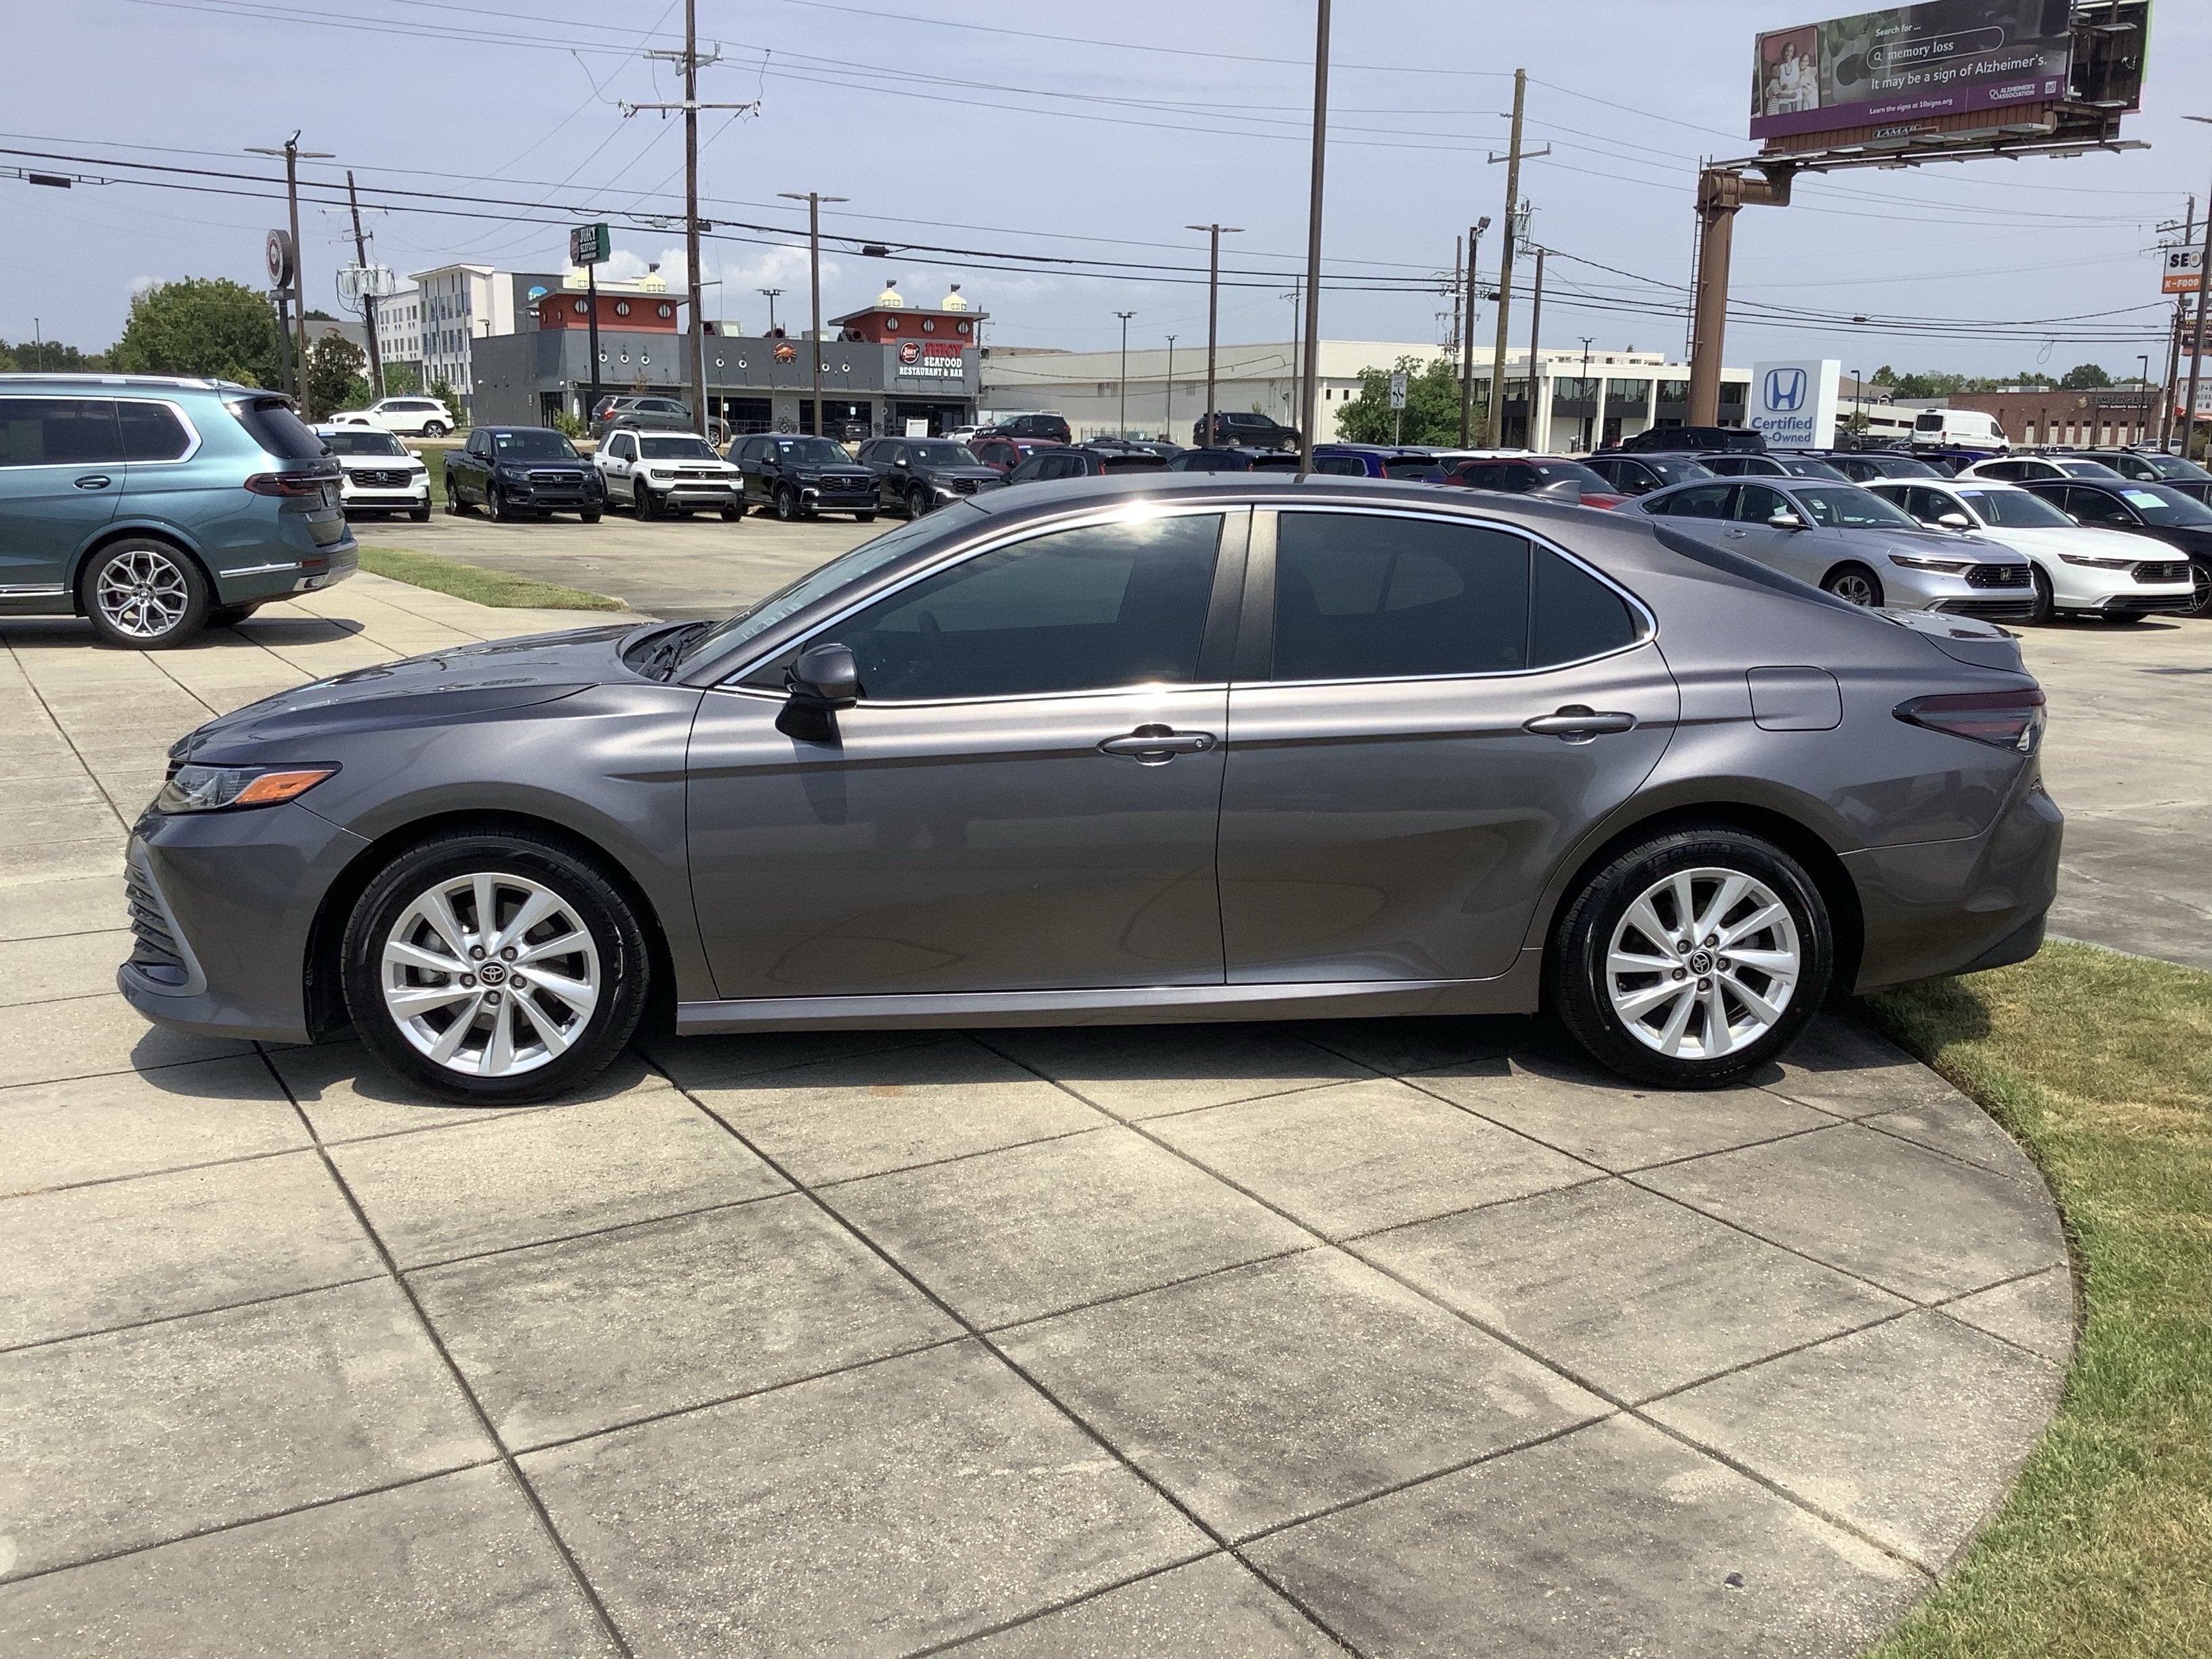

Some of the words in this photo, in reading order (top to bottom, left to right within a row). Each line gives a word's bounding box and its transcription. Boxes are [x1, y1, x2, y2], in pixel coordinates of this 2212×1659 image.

[1875, 25, 1900, 37] Search
[1902, 24, 1912, 32] for
[1888, 45, 1930, 59] memory
[1933, 41, 1954, 53] loss
[1871, 78, 1879, 89] It
[1882, 77, 1905, 89] may
[1908, 73, 1921, 85] be
[1924, 73, 1930, 82] a
[1933, 68, 1957, 83] sign
[1960, 64, 1973, 77] of
[1975, 54, 2047, 75] Alzheimer's.
[1999, 89, 2035, 100] ASSOCIATION
[1897, 103, 1911, 112] signs
[1919, 98, 1953, 108] 10signs.org
[579, 226, 596, 243] JUICY
[2169, 251, 2204, 268] SEO
[924, 356, 962, 368] SEAFOOD
[899, 367, 943, 376] RESTAURANT
[943, 369, 948, 377] &
[949, 369, 963, 377] BAR
[1751, 416, 1813, 430] Certified
[1762, 432, 1811, 443] e-Owned
